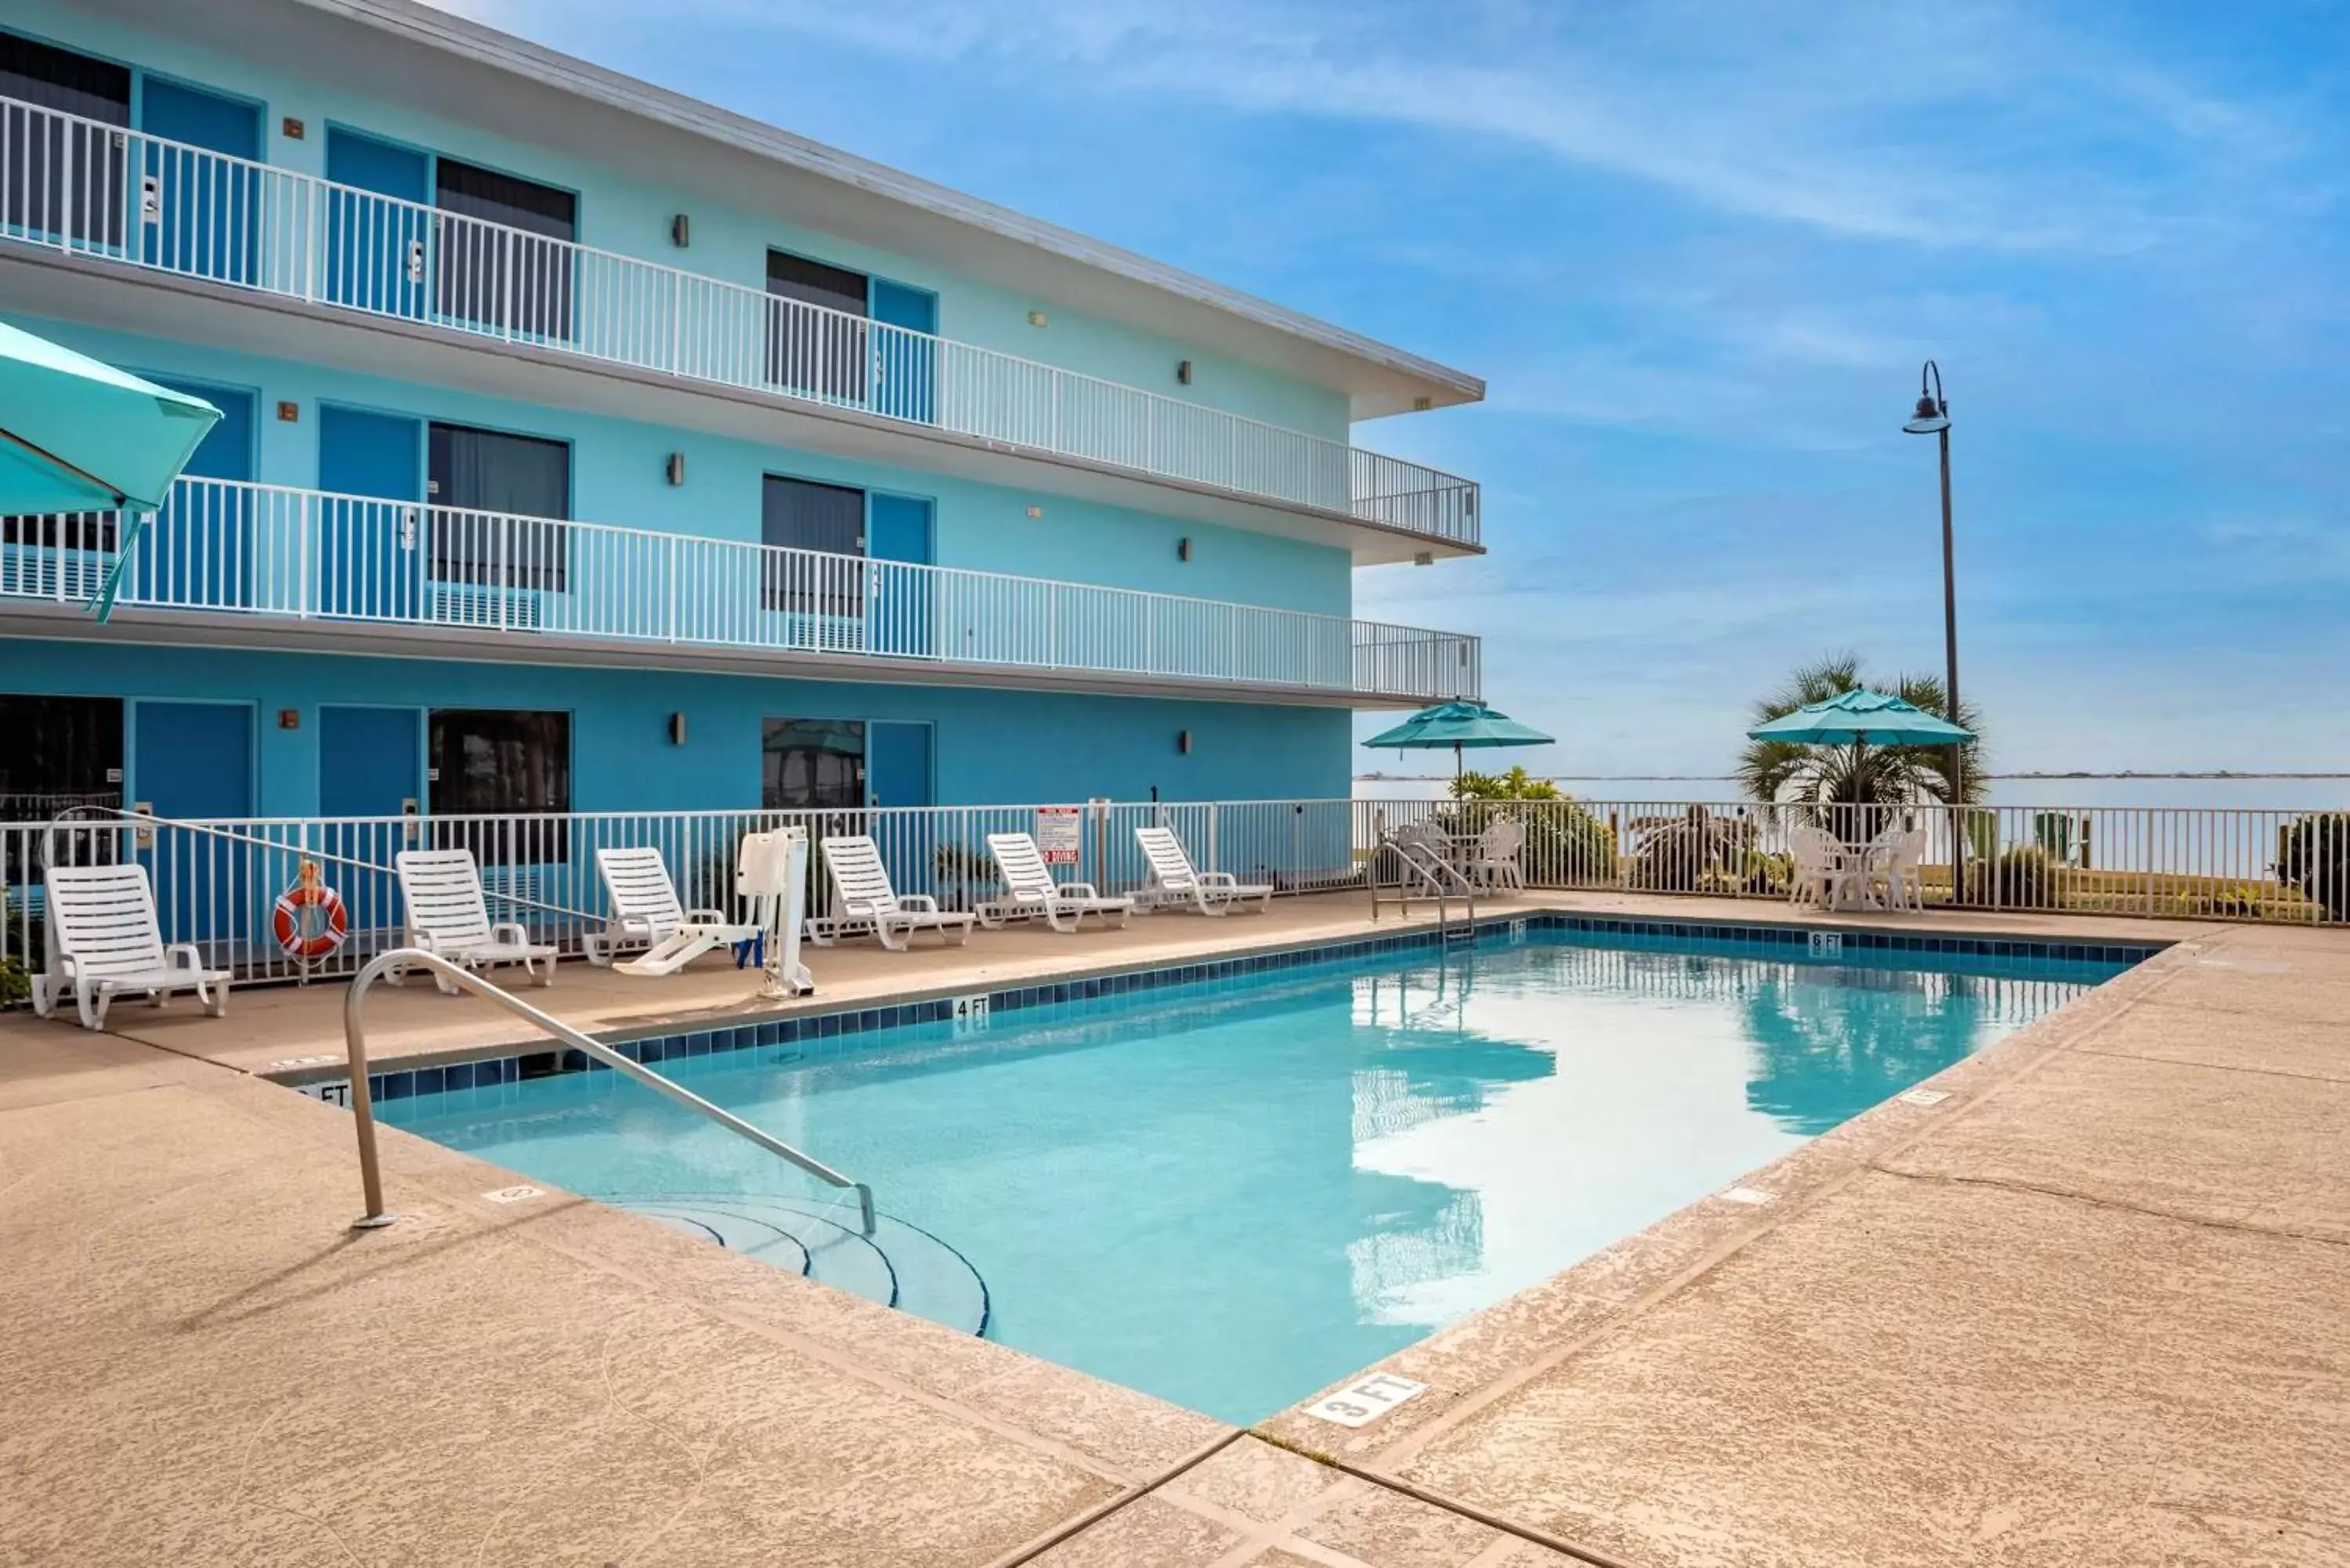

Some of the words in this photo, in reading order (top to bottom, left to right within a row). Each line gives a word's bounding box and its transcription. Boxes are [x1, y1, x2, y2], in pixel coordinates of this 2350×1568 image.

[1813, 934, 1821, 947] 6
[1826, 934, 1839, 948] FT
[958, 1000, 967, 1017] 4
[972, 997, 987, 1017] FT
[321, 1085, 348, 1107] FT
[1325, 1401, 1369, 1417] 3
[1351, 1375, 1419, 1402] FT
